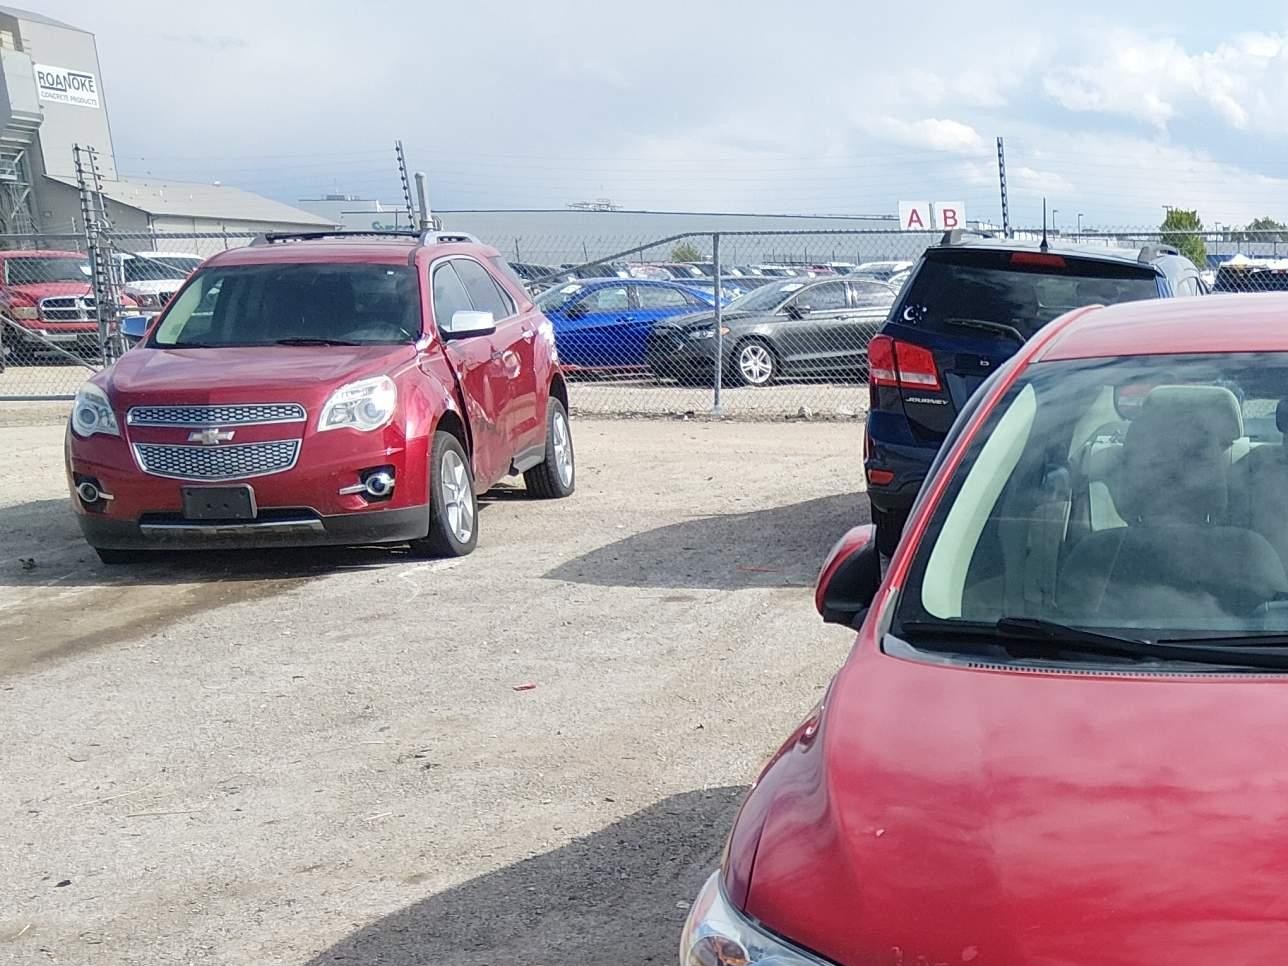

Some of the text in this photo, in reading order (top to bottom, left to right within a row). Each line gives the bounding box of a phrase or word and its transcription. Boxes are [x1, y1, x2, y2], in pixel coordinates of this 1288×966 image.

[37, 71, 95, 93] ROANOKE
[70, 95, 97, 105] PRODUCTS
[908, 208, 924, 228] A
[943, 208, 958, 228] B
[905, 397, 949, 405] JOURNEY
